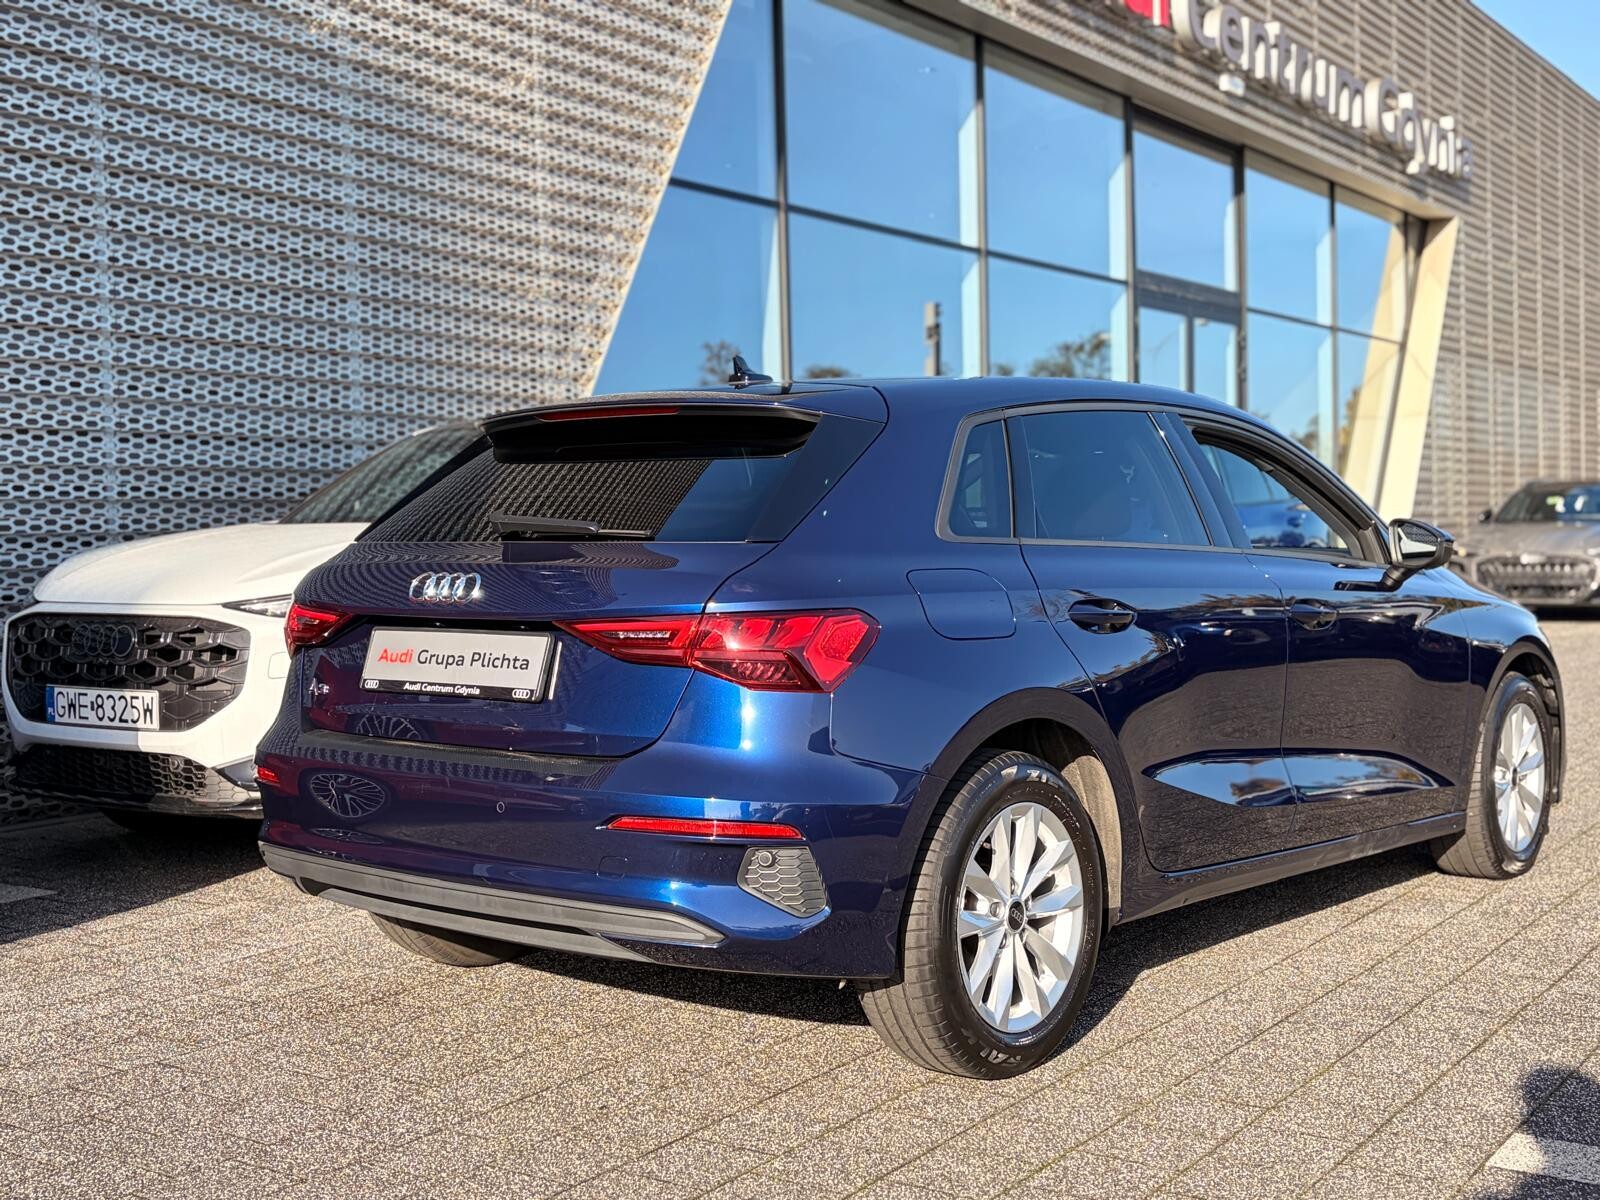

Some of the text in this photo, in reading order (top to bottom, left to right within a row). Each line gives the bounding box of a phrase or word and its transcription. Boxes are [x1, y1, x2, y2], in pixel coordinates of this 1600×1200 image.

[1170, 0, 1474, 178] Centrum Gdynia
[378, 648, 531, 671] Audi Grupa Plichta
[403, 681, 480, 696] Audi Centrum Gdynia
[55, 691, 154, 725] GWE 8325W
